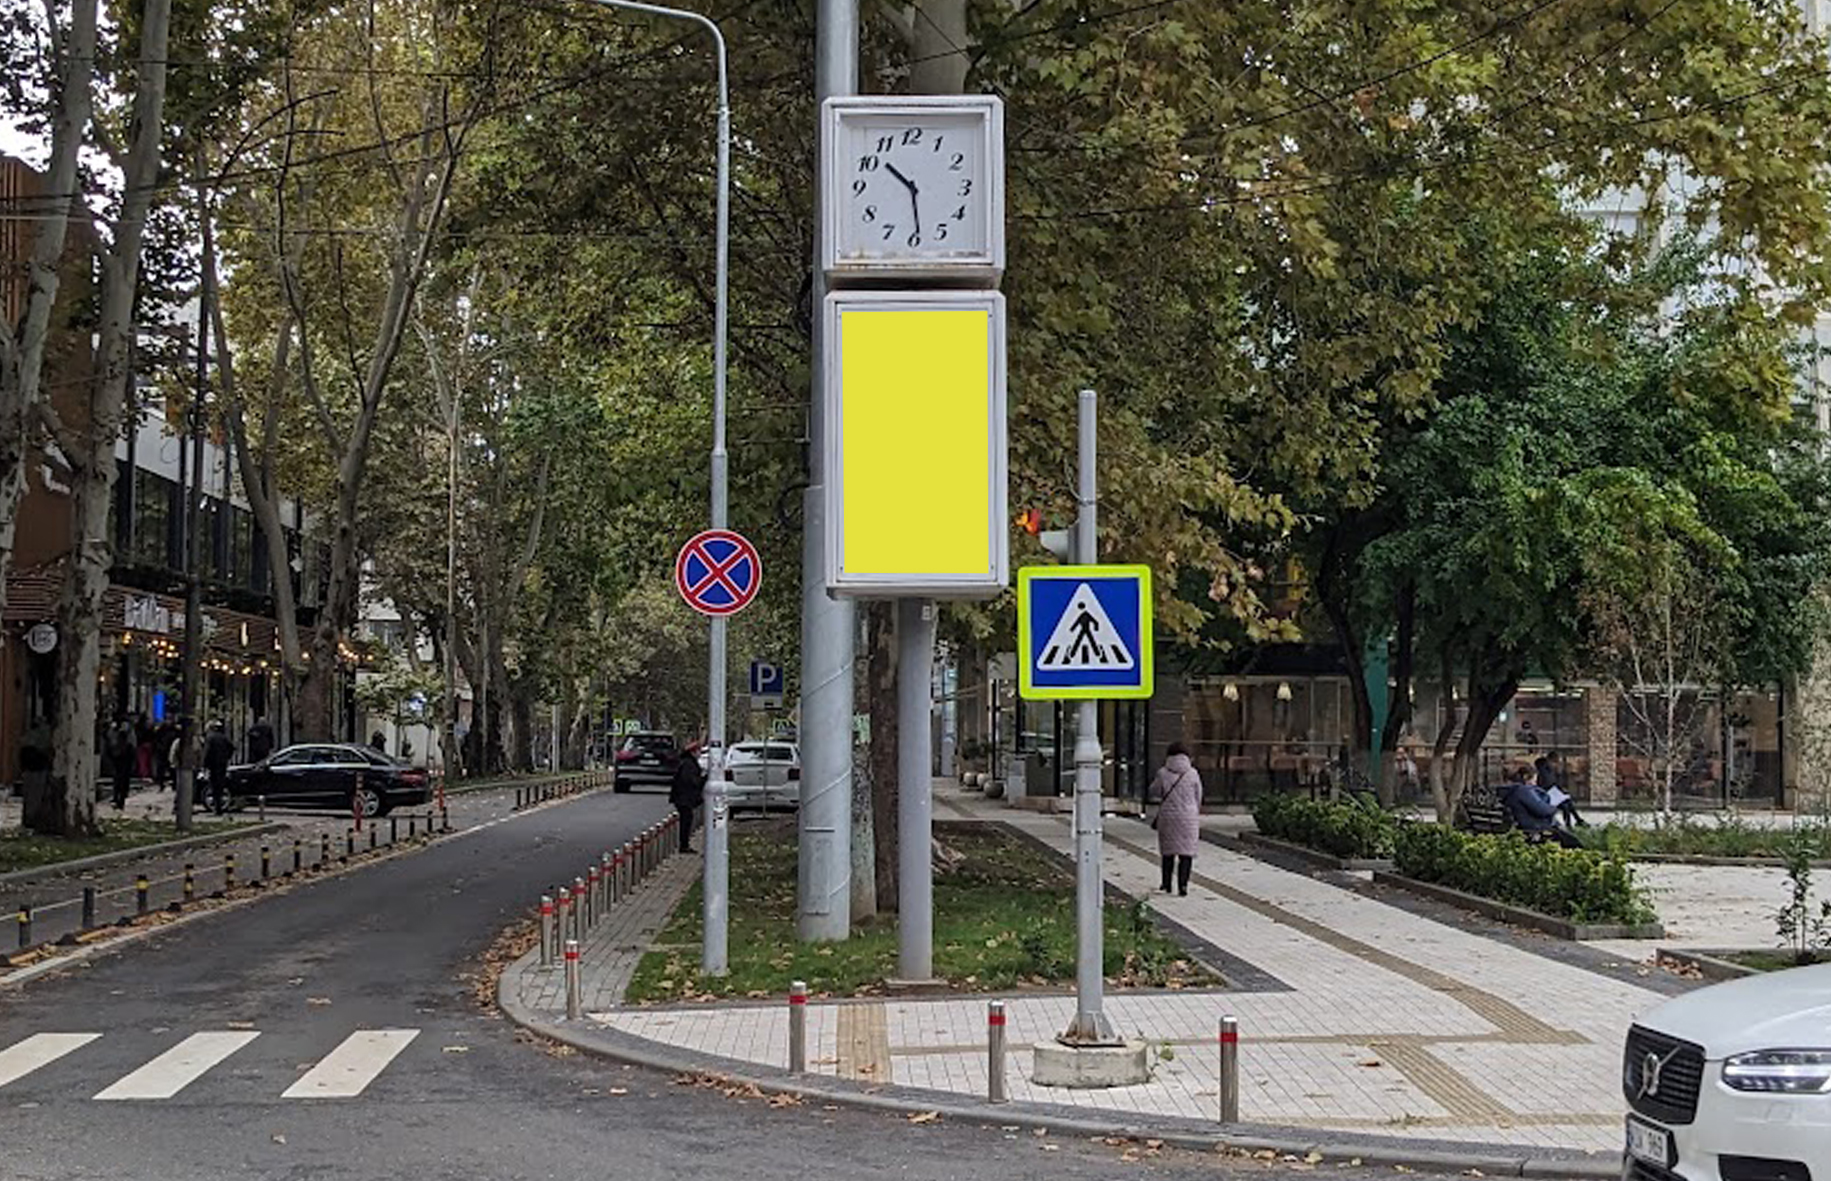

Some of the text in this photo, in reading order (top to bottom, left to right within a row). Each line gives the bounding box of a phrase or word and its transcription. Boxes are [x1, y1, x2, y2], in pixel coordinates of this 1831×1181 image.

[877, 135, 895, 153] 11
[901, 127, 923, 146] 12
[933, 136, 944, 152] 1
[858, 155, 879, 172] 10
[949, 152, 964, 171] 2
[853, 179, 866, 198] 9
[957, 179, 972, 196] 3
[862, 205, 877, 223] 8
[951, 205, 966, 221] 4
[882, 224, 895, 241] 7
[907, 231, 921, 248] 6
[934, 224, 948, 241] 5
[757, 663, 777, 693] P
